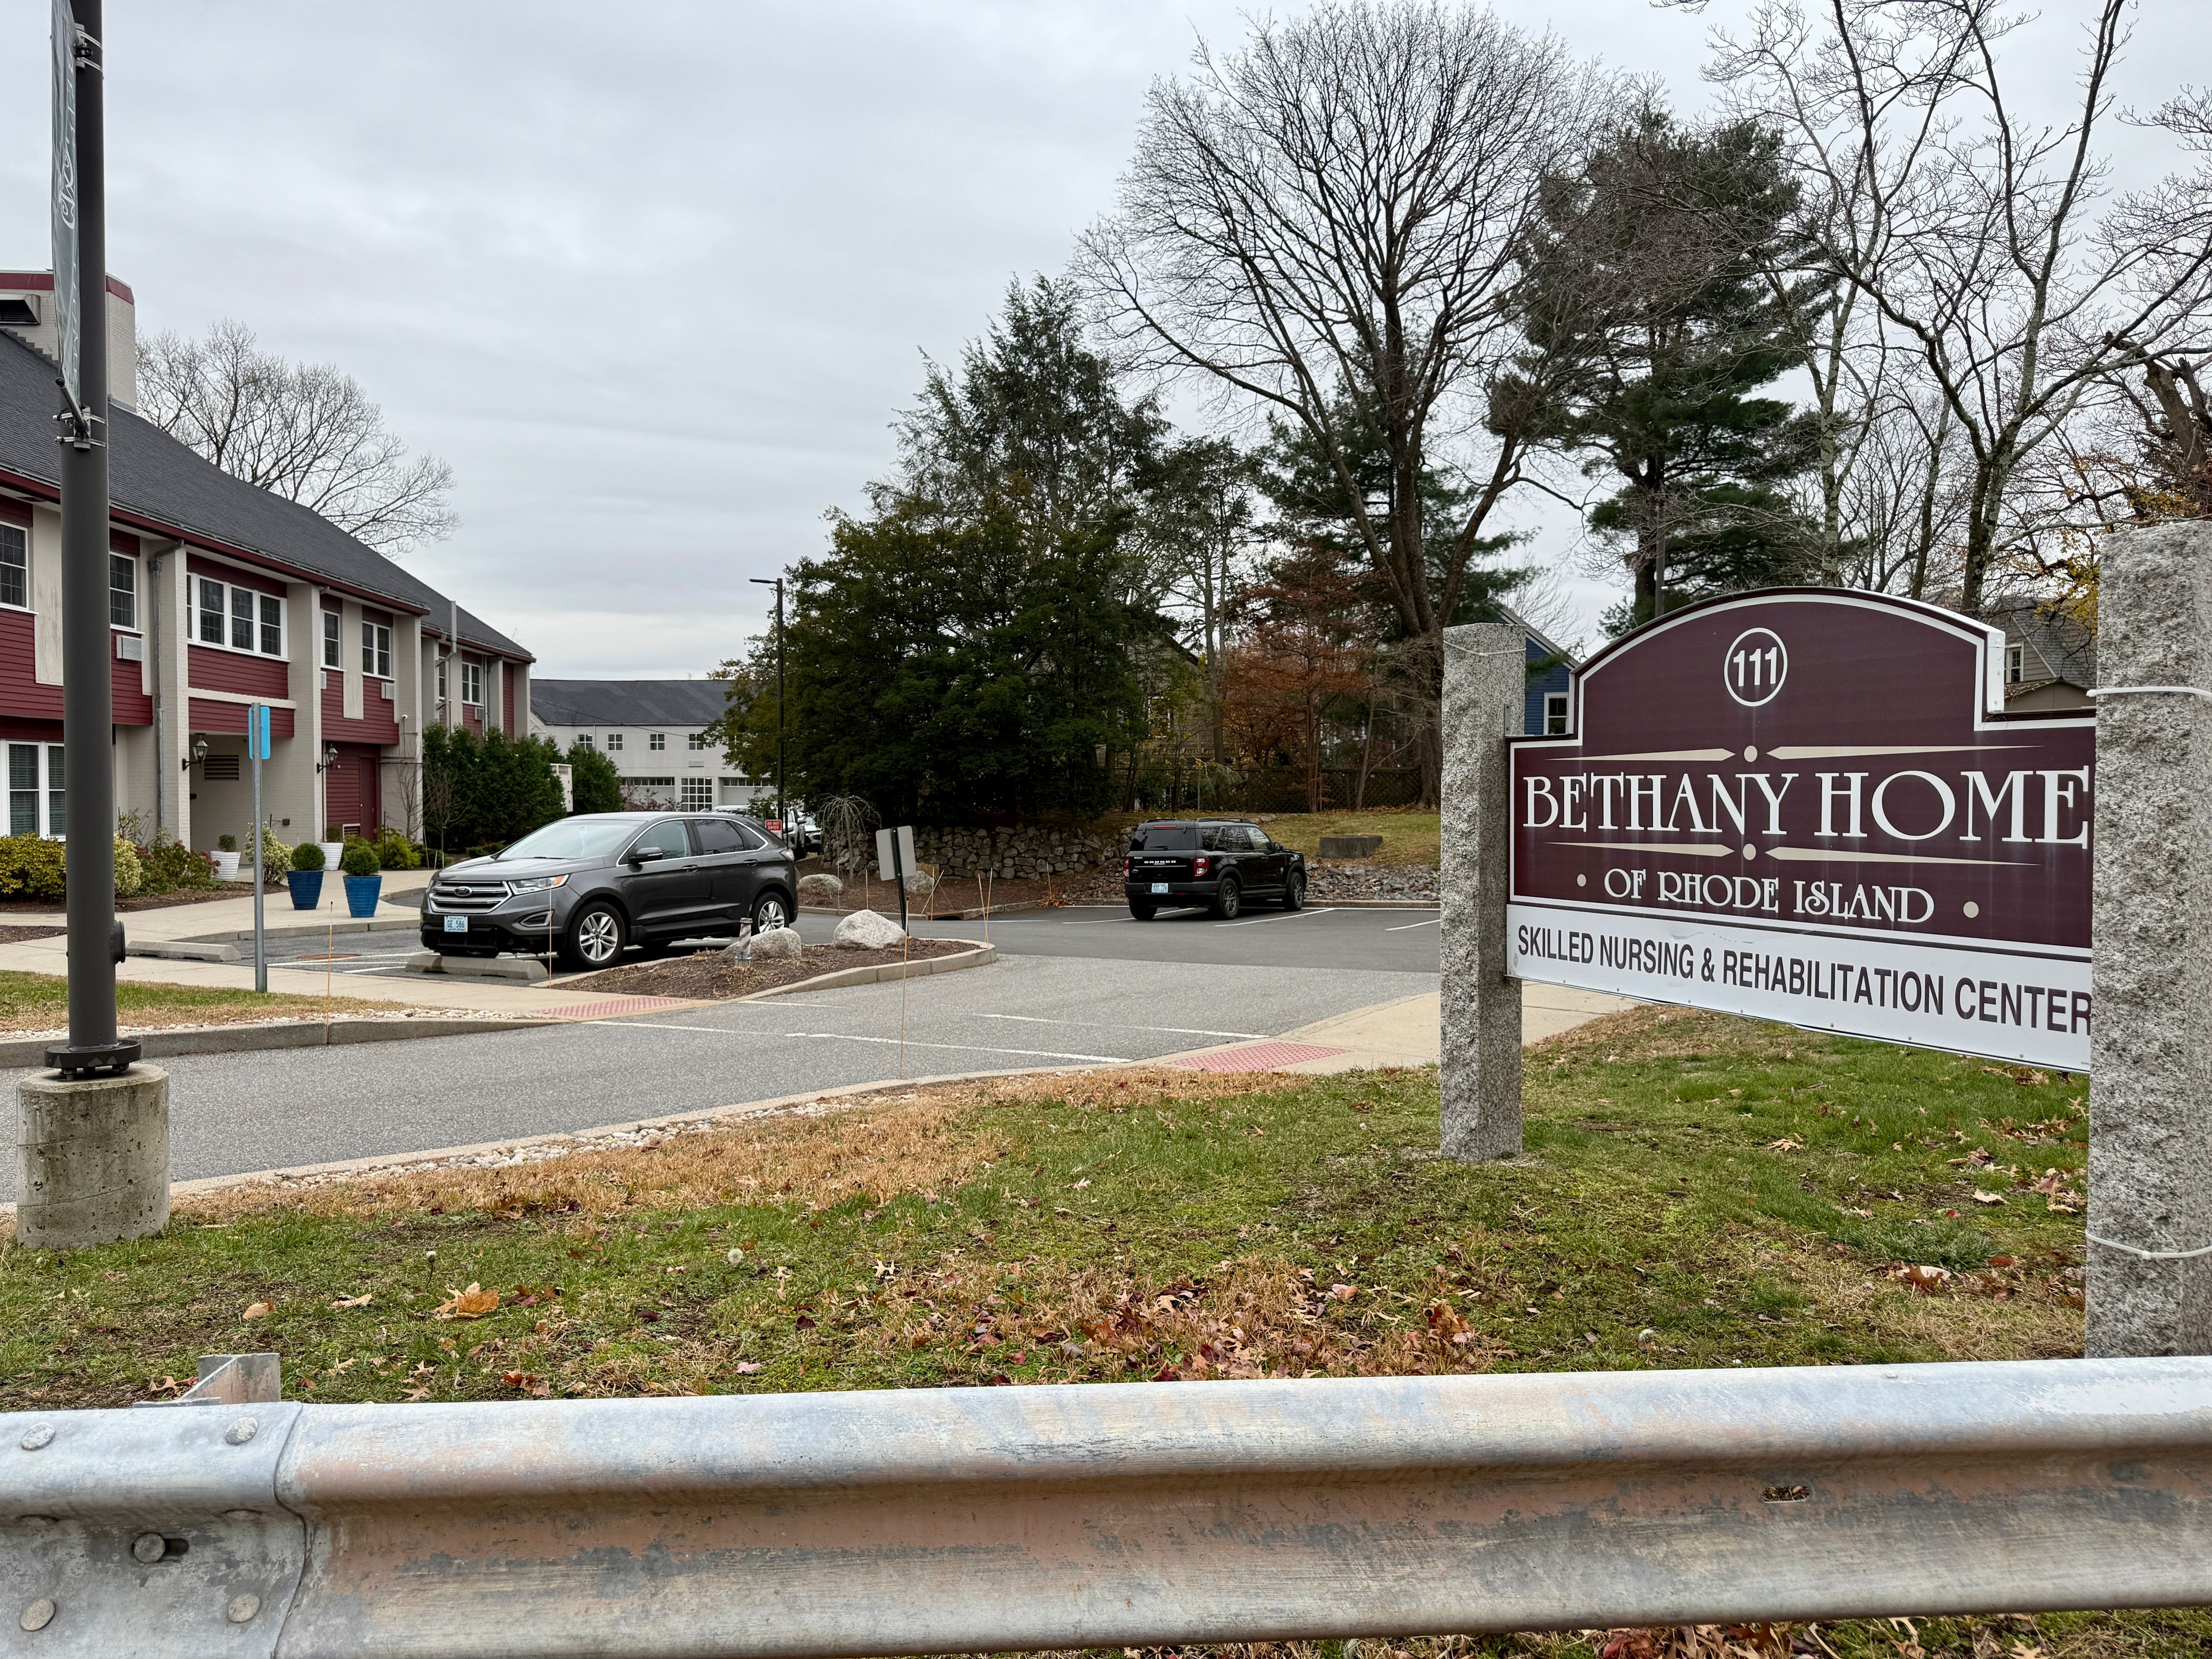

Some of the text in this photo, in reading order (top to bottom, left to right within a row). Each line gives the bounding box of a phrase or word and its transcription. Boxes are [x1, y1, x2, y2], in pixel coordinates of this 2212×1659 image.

[1733, 647, 1777, 687] 111
[1522, 765, 2089, 850] BETHANY HOME
[1604, 868, 1934, 922] OF RHODE ISLAND
[1518, 925, 2092, 1036] SKILLED NURSING & REHABILITATION CENTER
